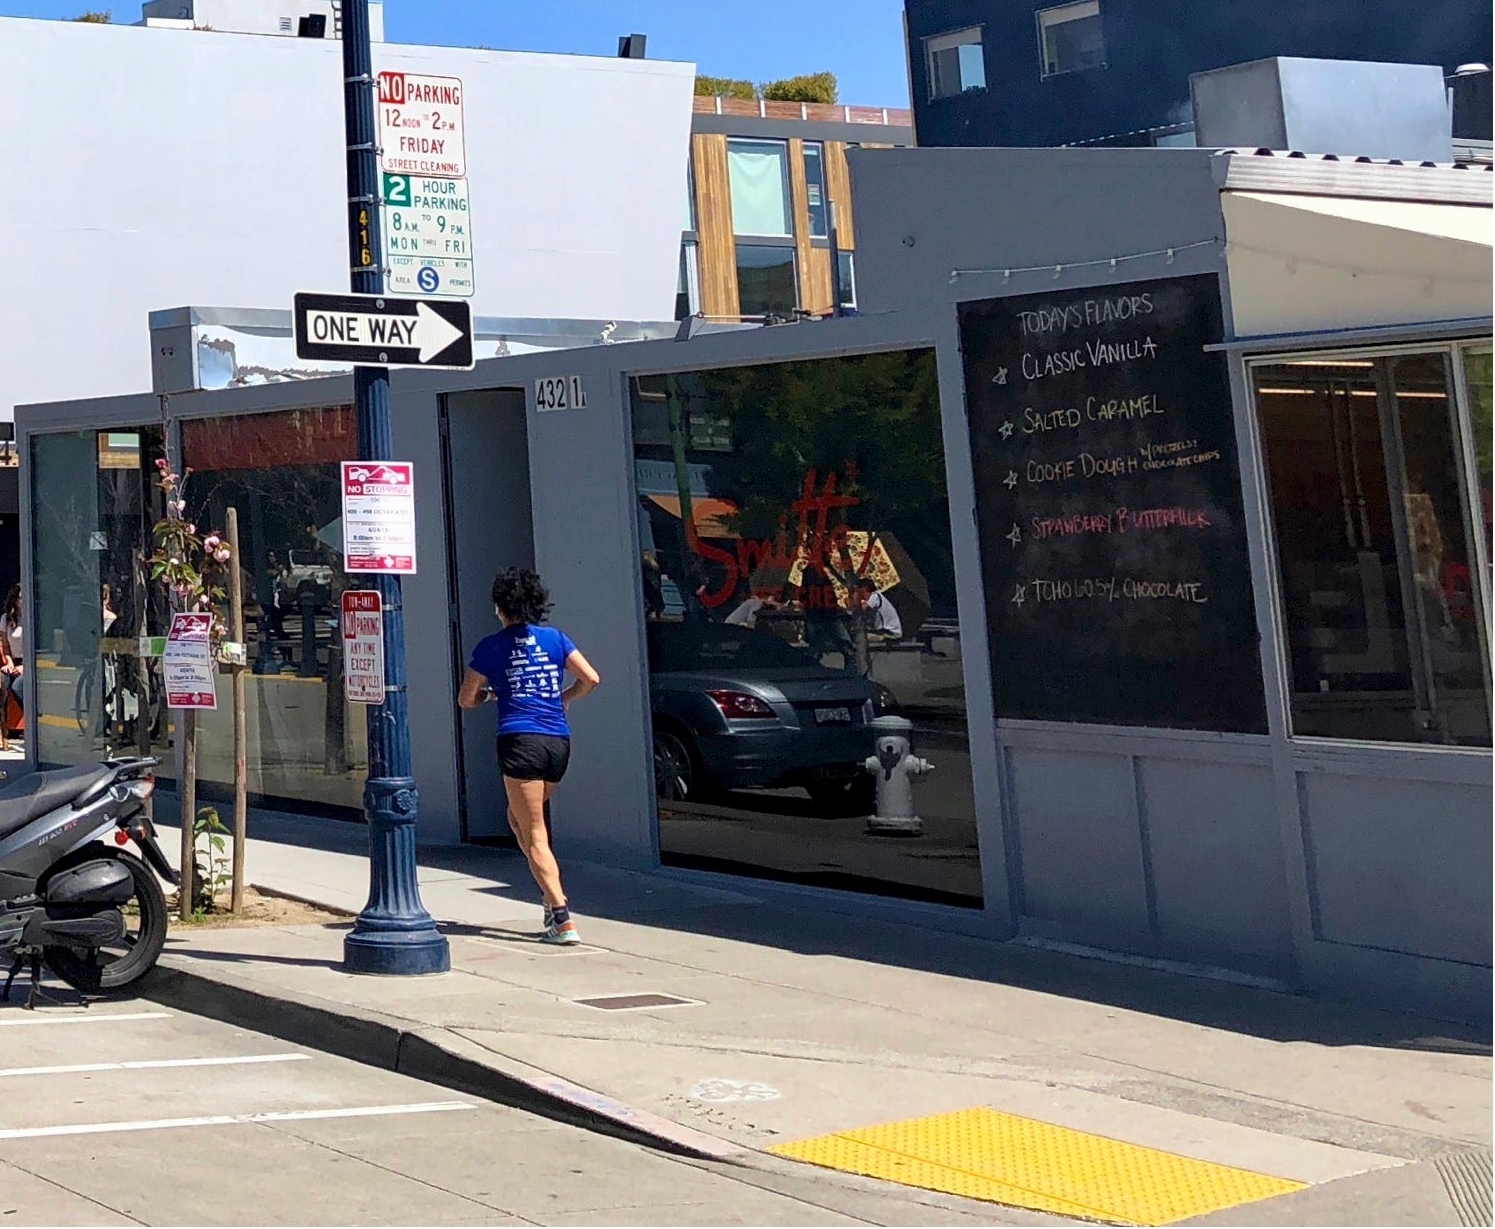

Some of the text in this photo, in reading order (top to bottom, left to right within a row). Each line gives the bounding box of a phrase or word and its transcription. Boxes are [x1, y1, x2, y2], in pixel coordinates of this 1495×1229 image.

[380, 74, 460, 105] NO PARKING
[386, 108, 401, 127] 12
[403, 118, 421, 128] NOON
[431, 111, 441, 130] 2
[400, 136, 445, 154] FRIDAY
[388, 158, 459, 173] STREET CLEANING
[388, 175, 407, 201] 2
[423, 180, 456, 195] HOUR
[414, 196, 467, 211] PARKING
[392, 212, 402, 231] 8
[436, 215, 446, 233] 9
[391, 237, 418, 250] MON
[445, 240, 465, 253] FRI
[420, 259, 445, 267] VEHICLES
[421, 269, 435, 290] S
[1016, 293, 1154, 335] TODAY'S FLAVORS
[315, 315, 417, 345] ONE WAY
[1022, 336, 1157, 380] CLASSIC VANILLA
[537, 379, 566, 409] 432
[1022, 394, 1165, 434] SALTED CARAMEL
[1026, 452, 1138, 482] COOKIE DOUGH
[347, 486, 408, 494] NO STOPPING
[1033, 514, 1112, 539] STRAWBERRY
[1122, 578, 1208, 603] CHOCOLATE
[345, 611, 379, 636] NO PARKING
[351, 642, 376, 656] ANY TIME
[351, 658, 376, 672] EXCEPT
